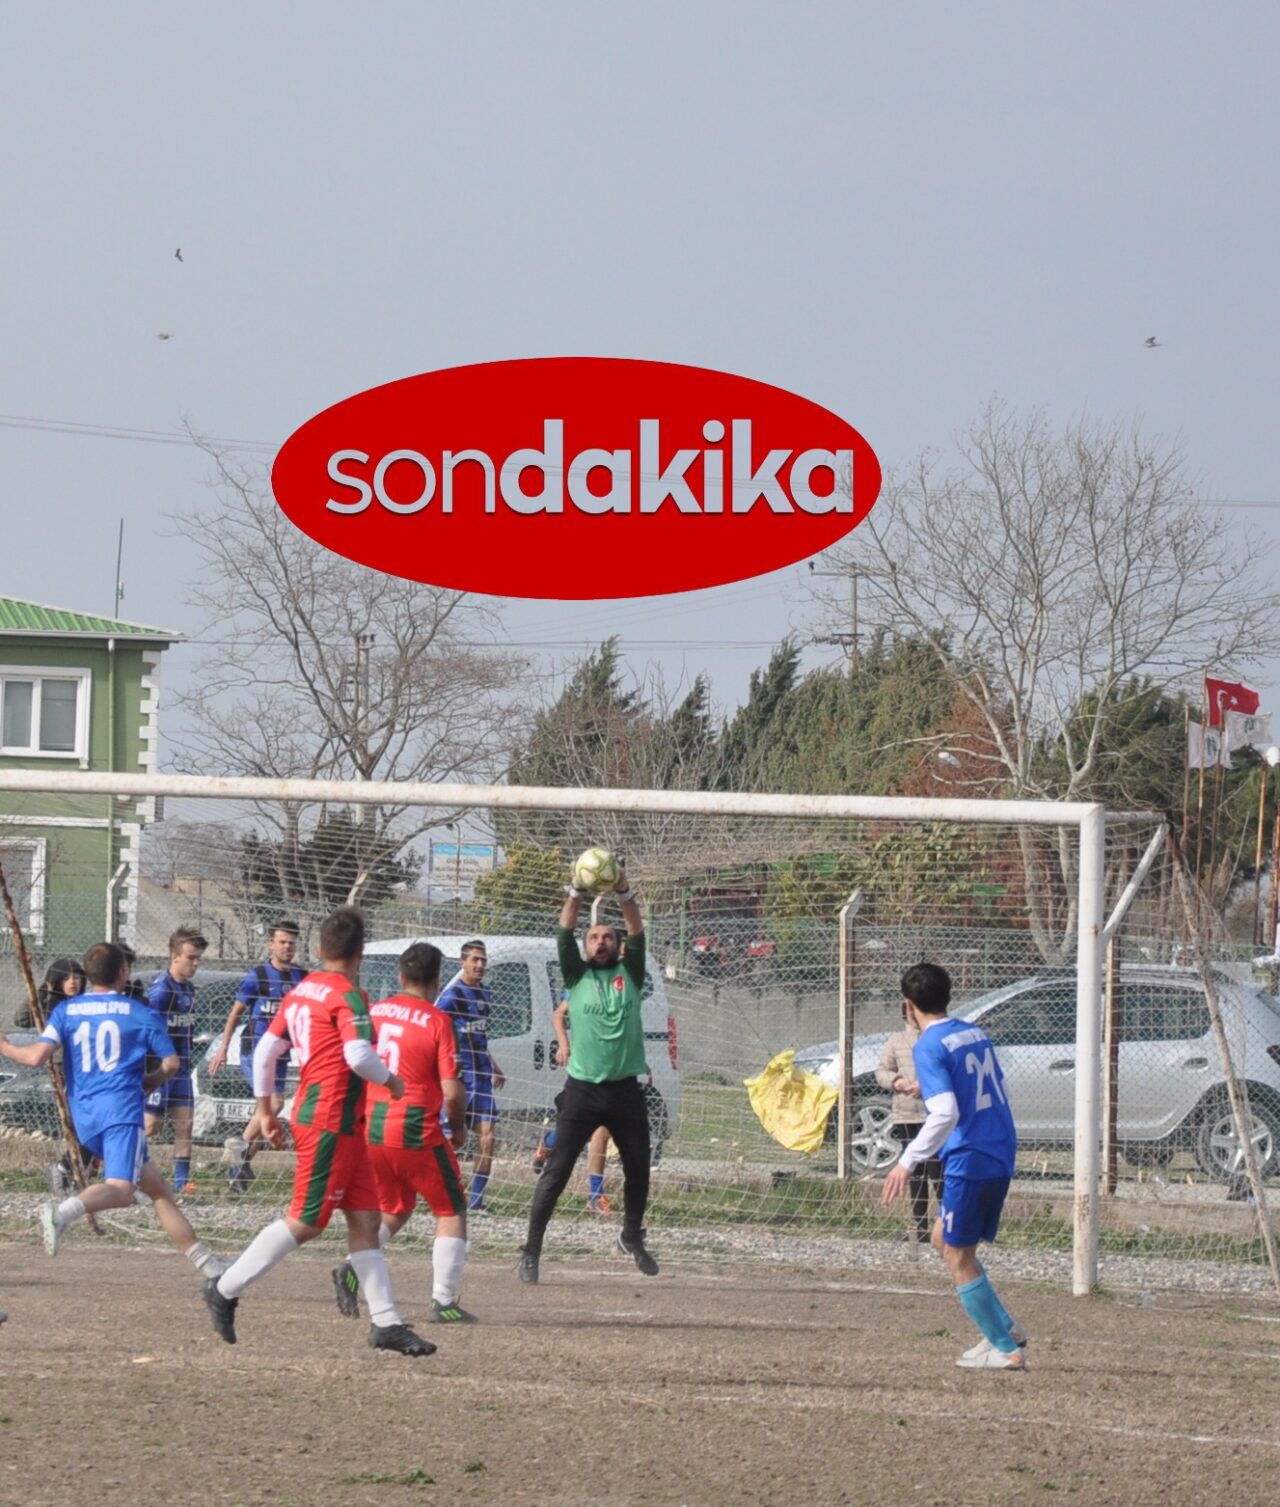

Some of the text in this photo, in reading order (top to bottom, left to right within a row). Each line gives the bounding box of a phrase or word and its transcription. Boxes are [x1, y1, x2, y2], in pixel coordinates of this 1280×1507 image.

[73, 1020, 120, 1072] 10
[376, 1022, 404, 1076] 5
[965, 1047, 1005, 1112] 21
